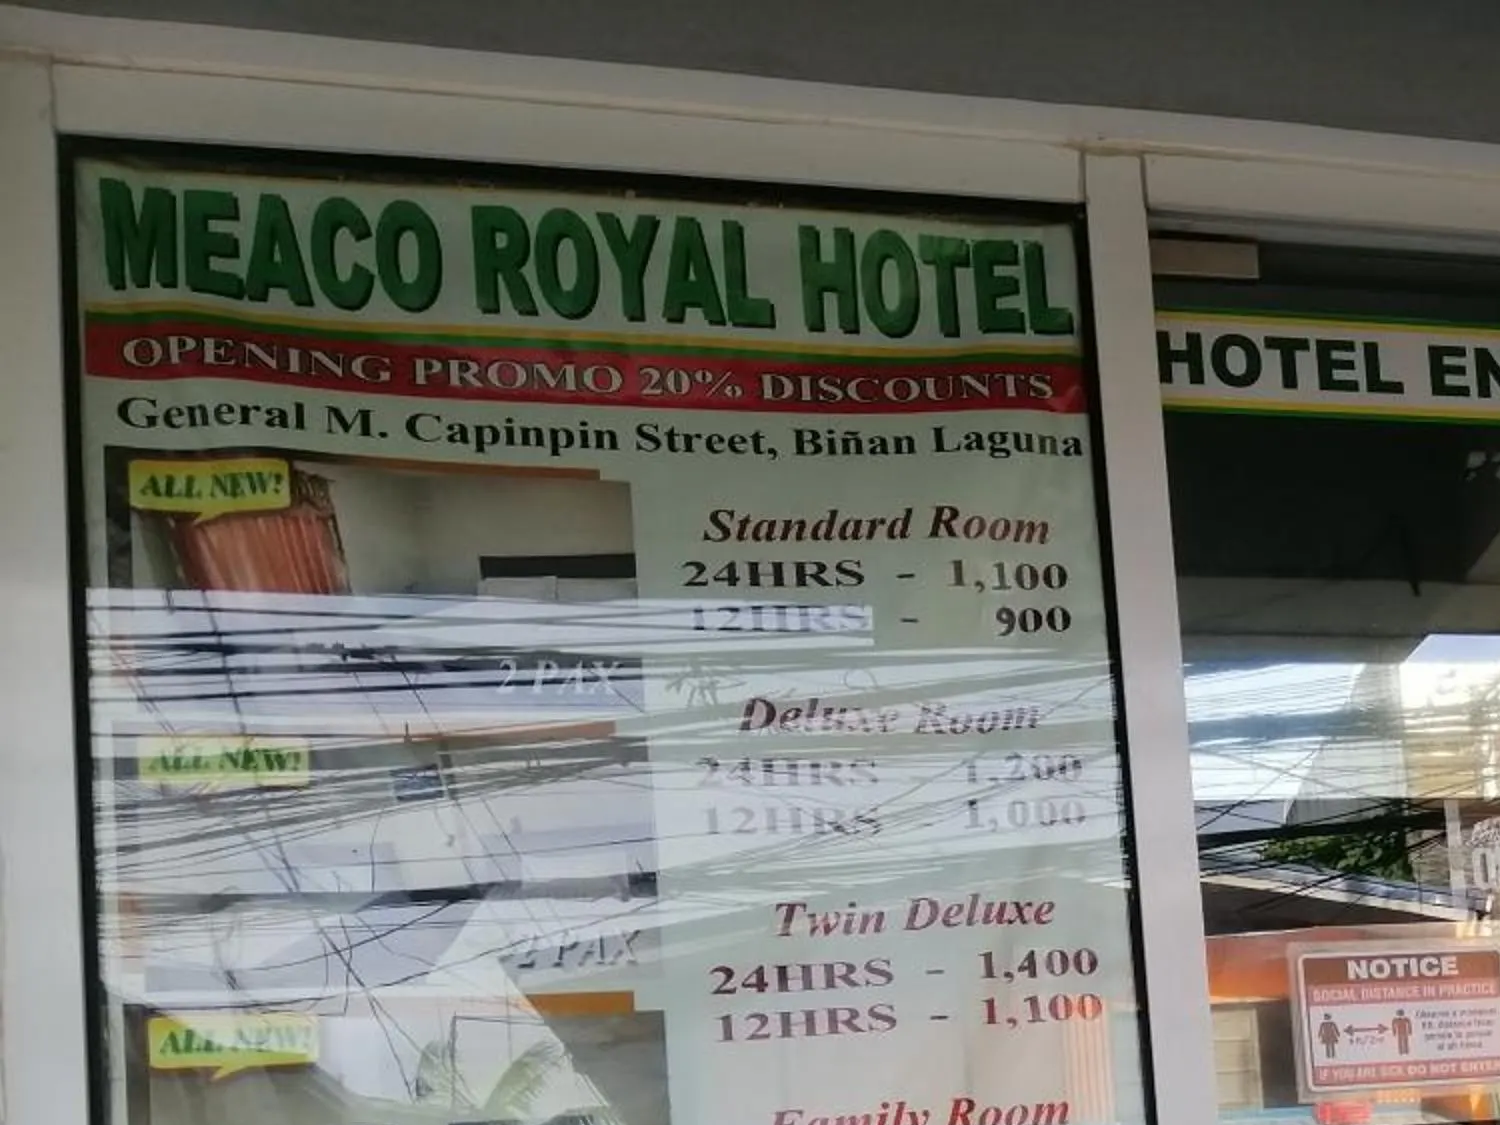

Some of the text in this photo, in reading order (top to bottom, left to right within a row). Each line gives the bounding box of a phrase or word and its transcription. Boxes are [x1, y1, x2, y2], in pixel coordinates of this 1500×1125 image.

[100, 178, 1074, 339] MEACO ROYAL HOTEL
[123, 337, 1053, 402] OPENING PROMO 20% DISCOUNTS
[1155, 330, 1404, 395] HOTEL
[117, 397, 1084, 462] General M. Capinpin Street, Biñan Laguna
[139, 470, 284, 499] ALL NEW!
[703, 505, 1050, 545] Standard Room
[681, 559, 865, 588] 24HRS
[948, 559, 1069, 592] 1,100
[693, 604, 870, 632] 12HRS
[995, 606, 1072, 637] 900
[533, 659, 624, 695] PAX
[740, 697, 1043, 735] Deluxe Room
[149, 747, 301, 772] ALL NEW!
[706, 806, 882, 837] 12HRS
[776, 894, 1056, 937] Twin Deluxe
[709, 958, 895, 995] 24HRS
[977, 948, 1099, 983] 1,400
[1347, 955, 1459, 981] NOTICE
[1313, 981, 1496, 1003] SOCIAL DISTANCE IN PRACTICE
[718, 1003, 897, 1043] 12HRS
[981, 994, 1103, 1029] 1,100
[159, 1025, 217, 1053] ALL
[1406, 1064, 1427, 1076] DO
